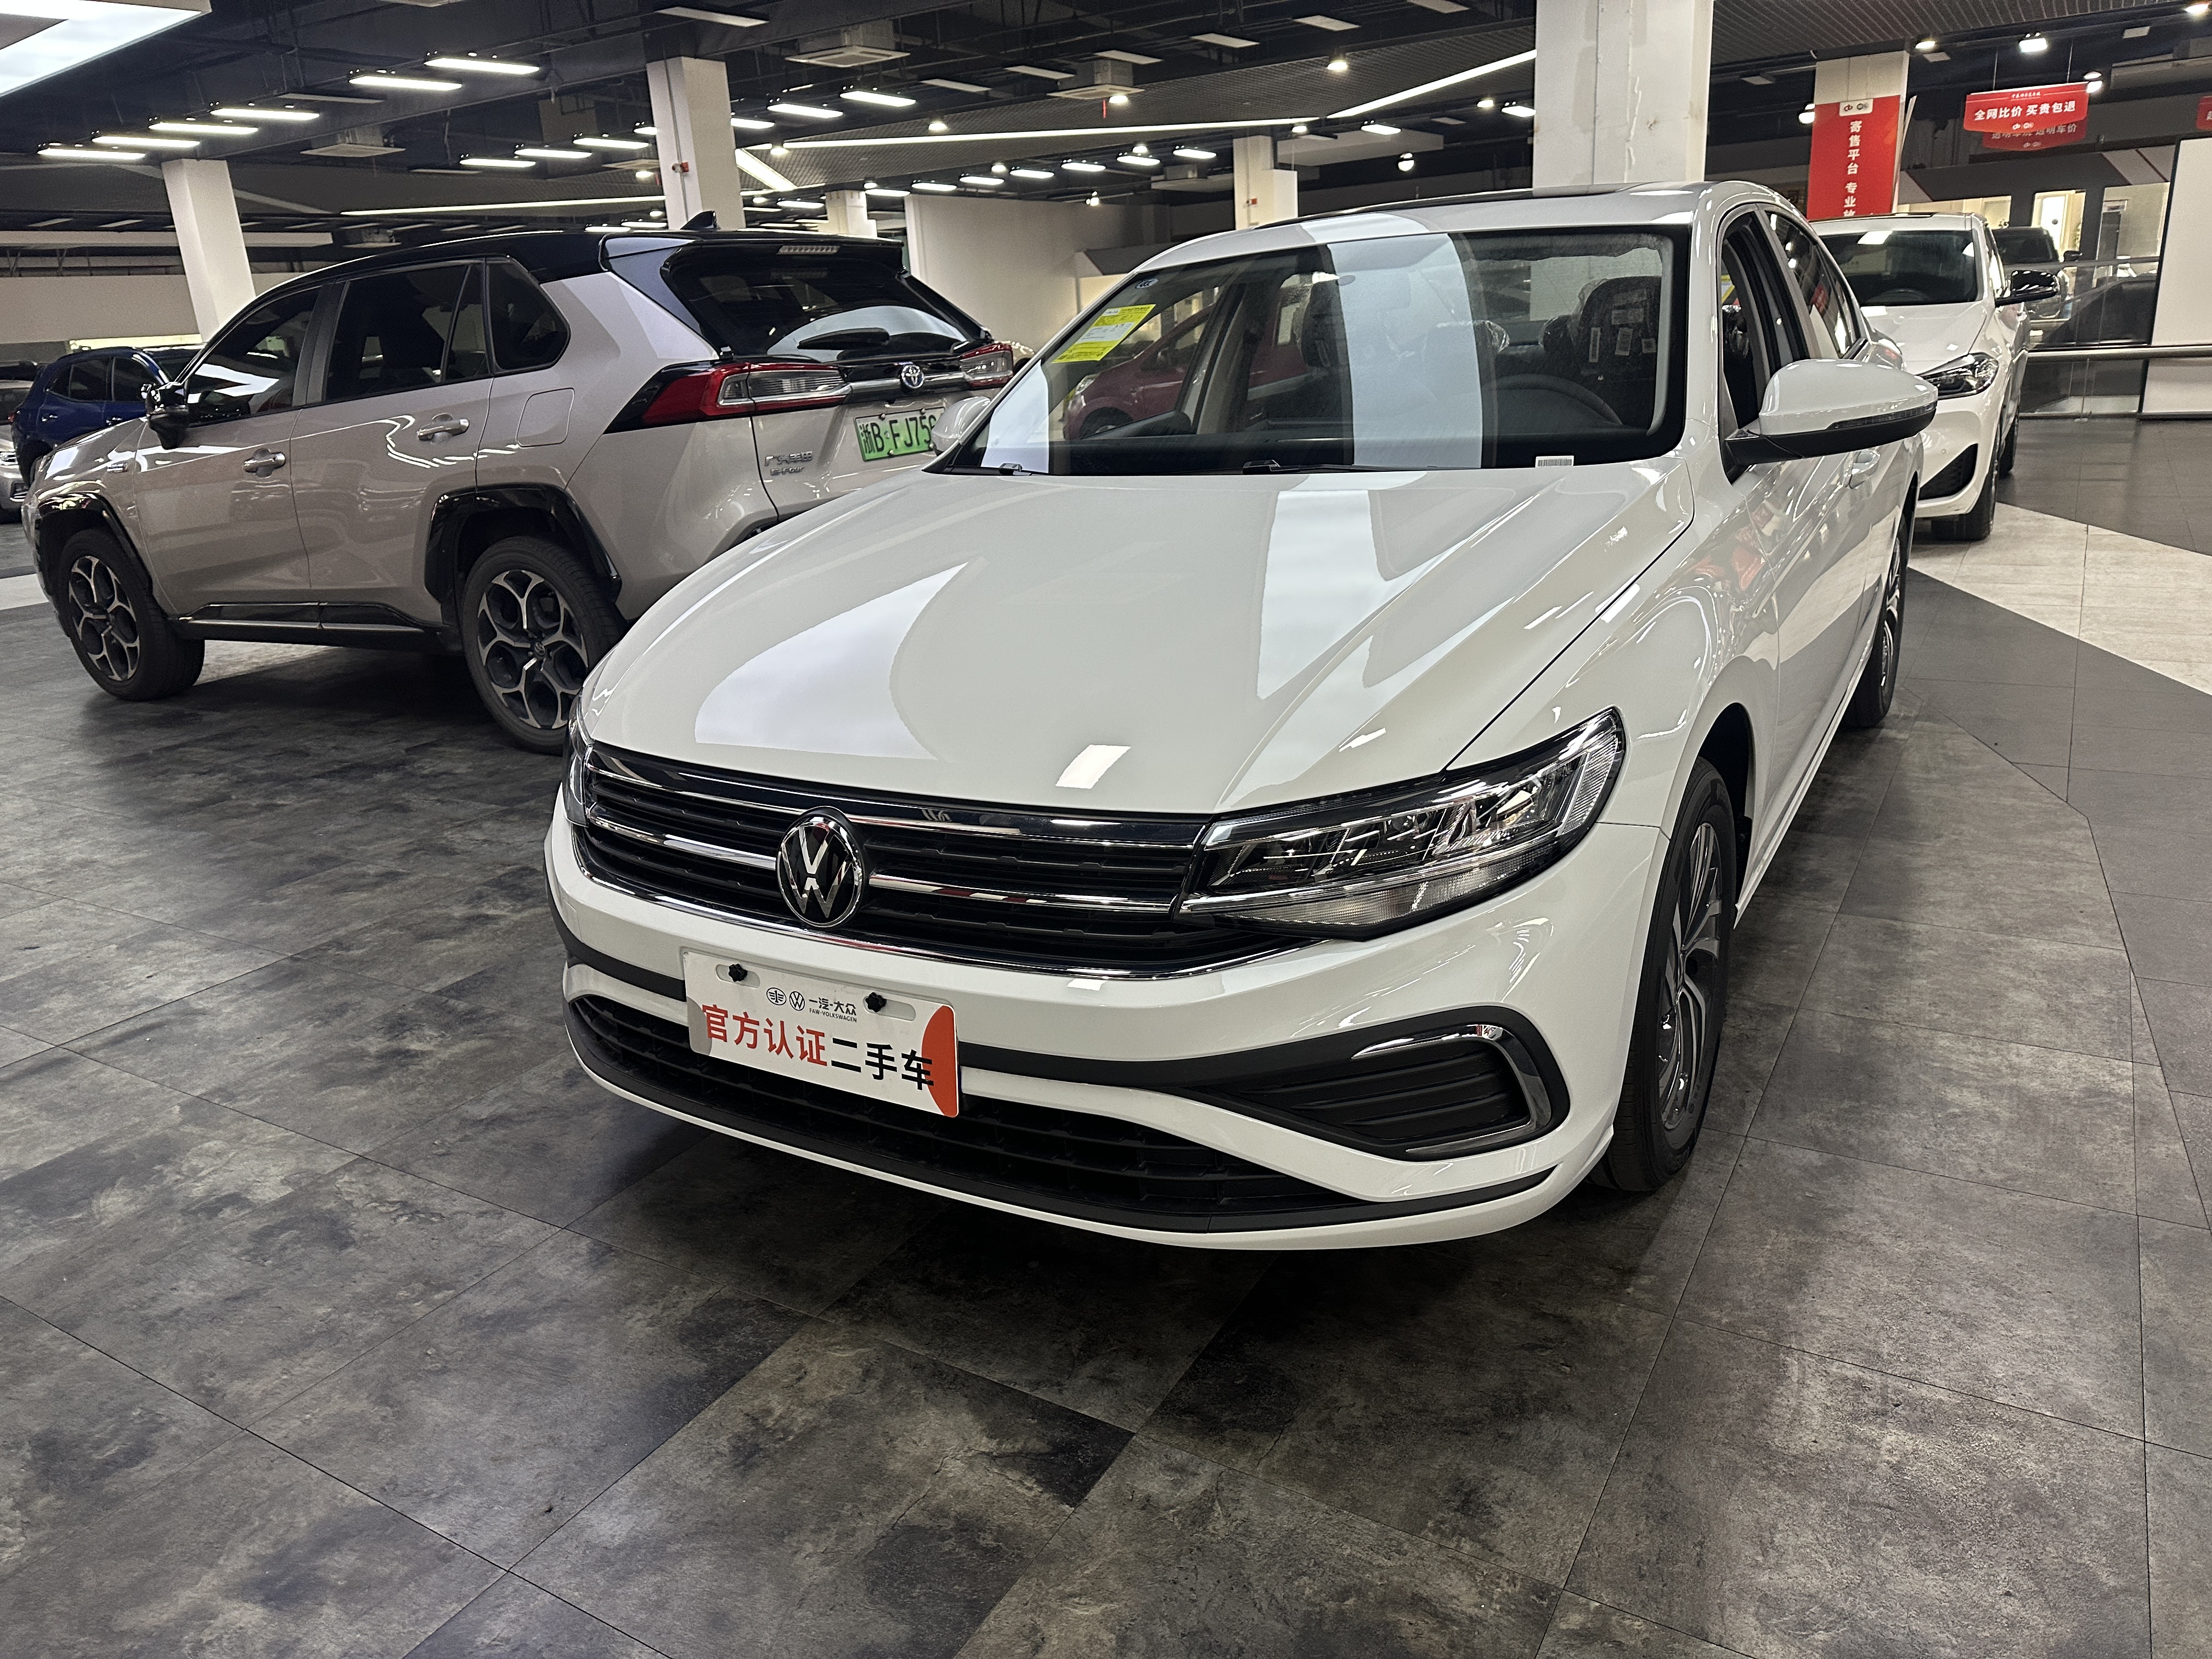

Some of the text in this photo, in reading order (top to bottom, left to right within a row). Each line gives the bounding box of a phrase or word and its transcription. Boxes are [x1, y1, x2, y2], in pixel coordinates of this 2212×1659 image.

[1974, 100, 2076, 121] 全网比价 买贵包退
[1848, 120, 1863, 175] 寄售平台
[809, 1008, 857, 1023] FAW-VOLKSWAGEN
[702, 1004, 934, 1091] 官方认证二手车
